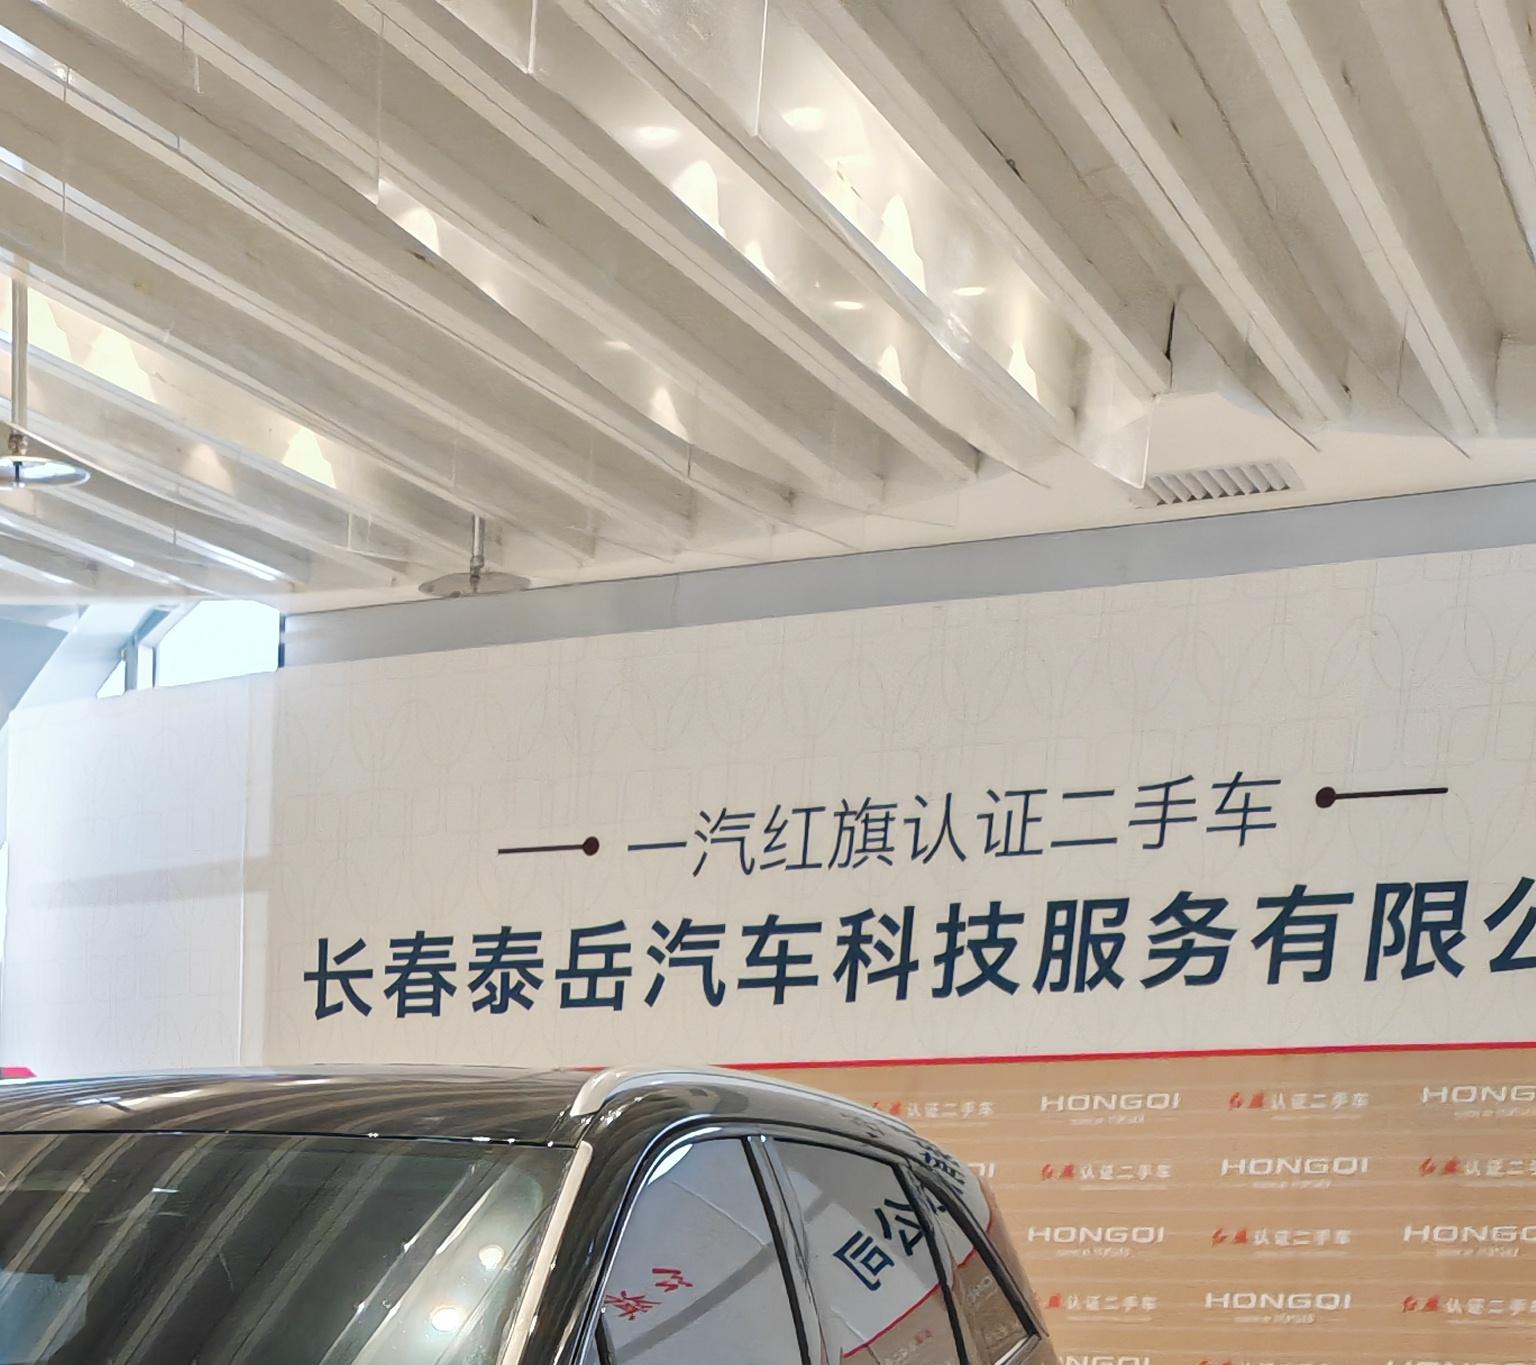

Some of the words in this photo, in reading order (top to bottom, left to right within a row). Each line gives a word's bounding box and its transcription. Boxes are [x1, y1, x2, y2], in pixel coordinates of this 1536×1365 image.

[627, 769, 1283, 879] 一汽红旗认证二手车
